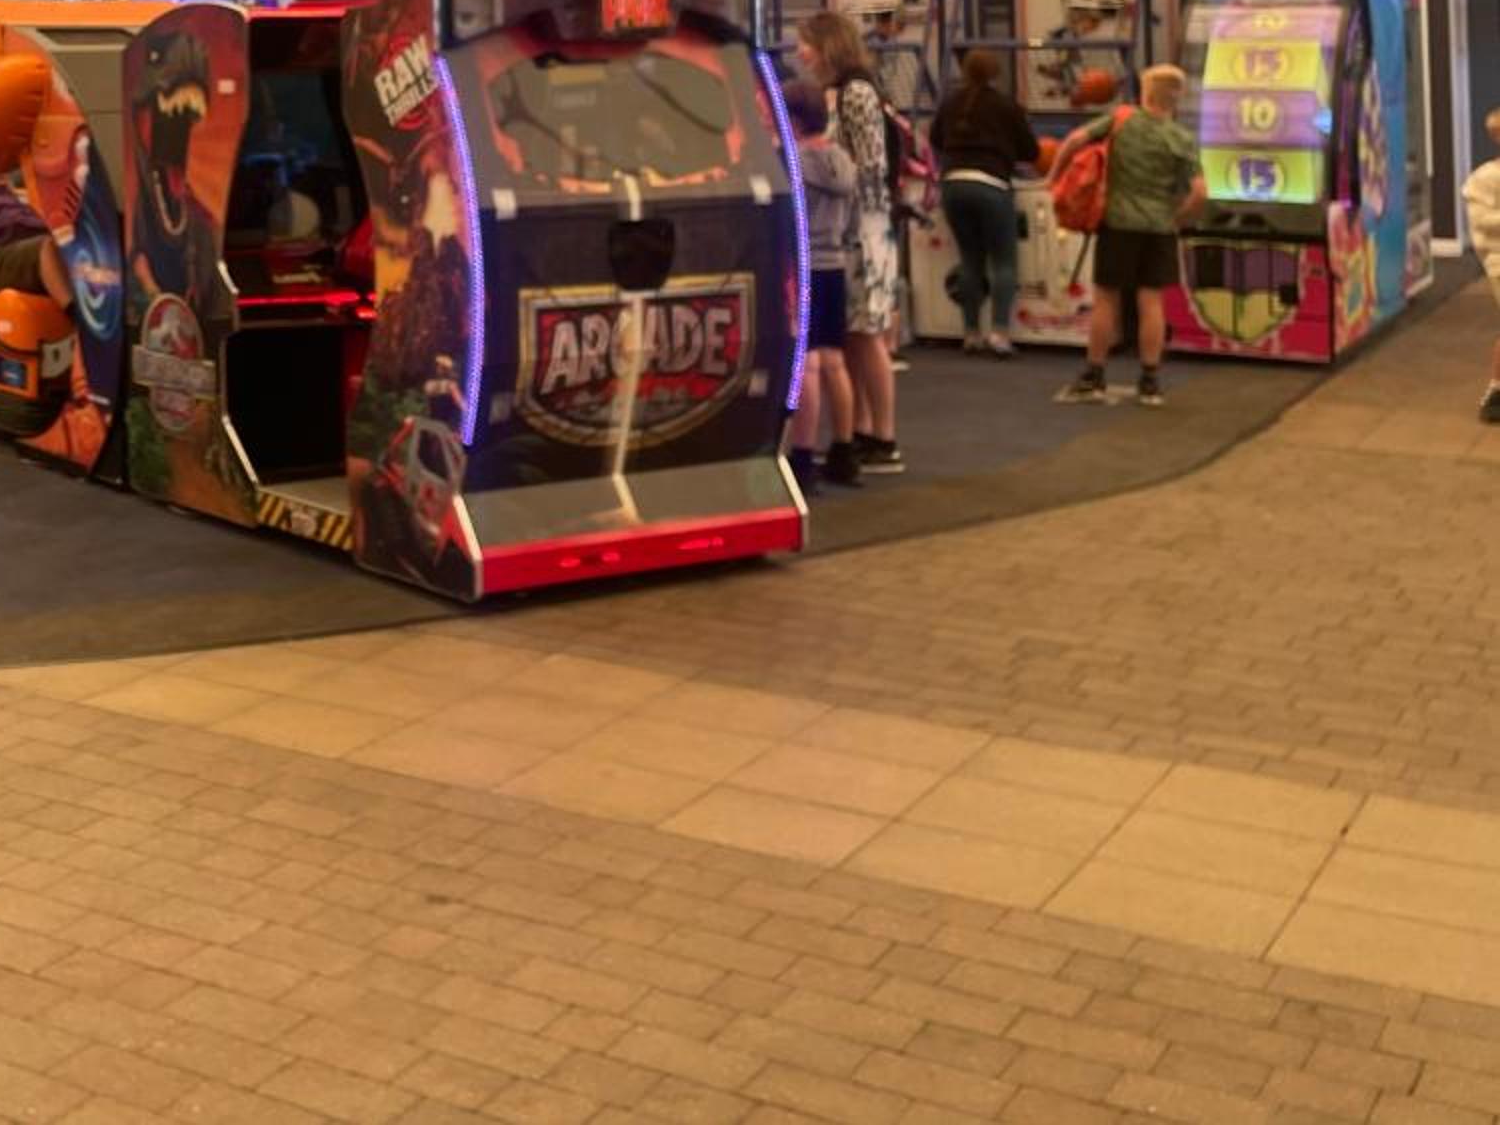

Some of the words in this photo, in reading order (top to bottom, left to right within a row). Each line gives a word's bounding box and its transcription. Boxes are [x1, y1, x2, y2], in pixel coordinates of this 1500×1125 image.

[373, 32, 432, 108] RAW
[1238, 97, 1278, 130] 10
[1239, 157, 1281, 192] 15
[539, 301, 732, 396] ARCADE
